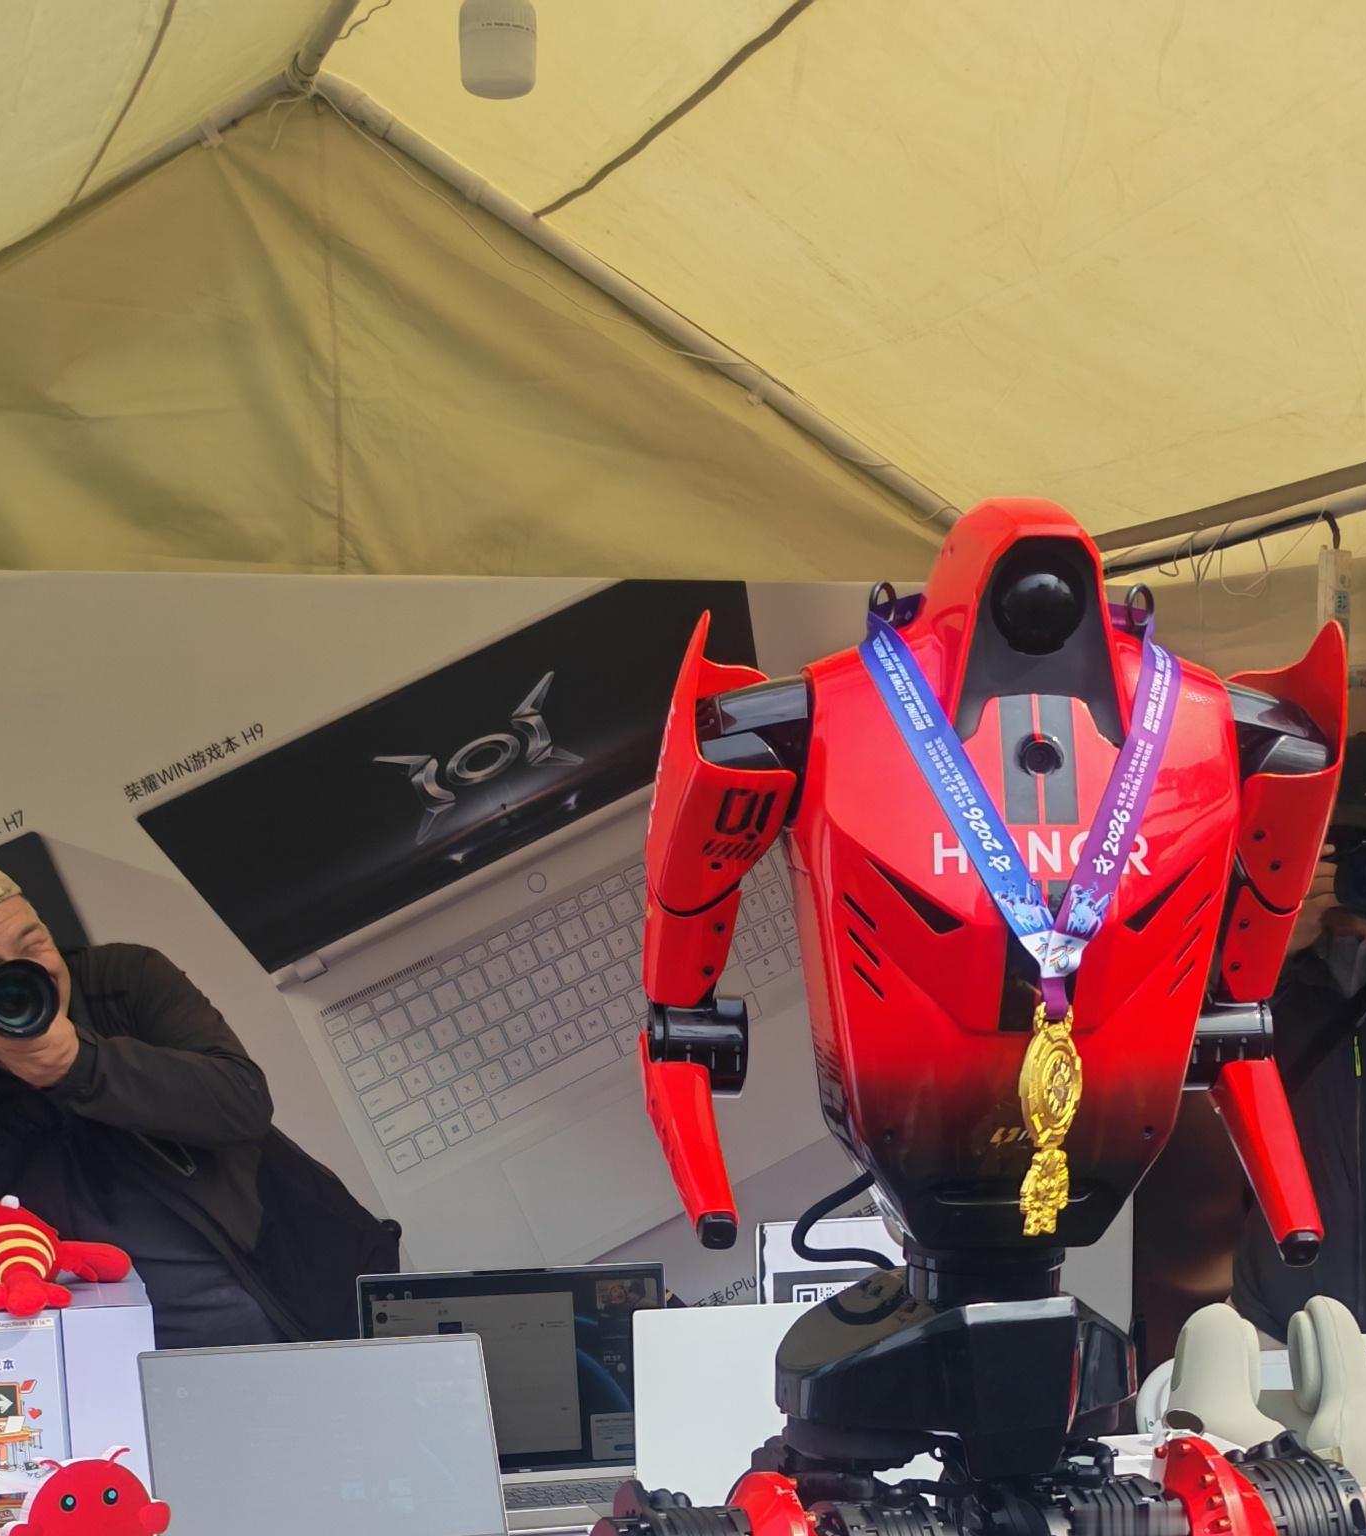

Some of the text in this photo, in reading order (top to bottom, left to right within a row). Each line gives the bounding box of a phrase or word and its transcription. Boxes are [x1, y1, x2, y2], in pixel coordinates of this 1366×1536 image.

[123, 723, 264, 803] 荣耀WIN游戏本 H9
[3, 810, 25, 833] H7
[961, 807, 1004, 851] 2026
[1102, 809, 1131, 857] 2026
[933, 831, 1152, 876] HNR
